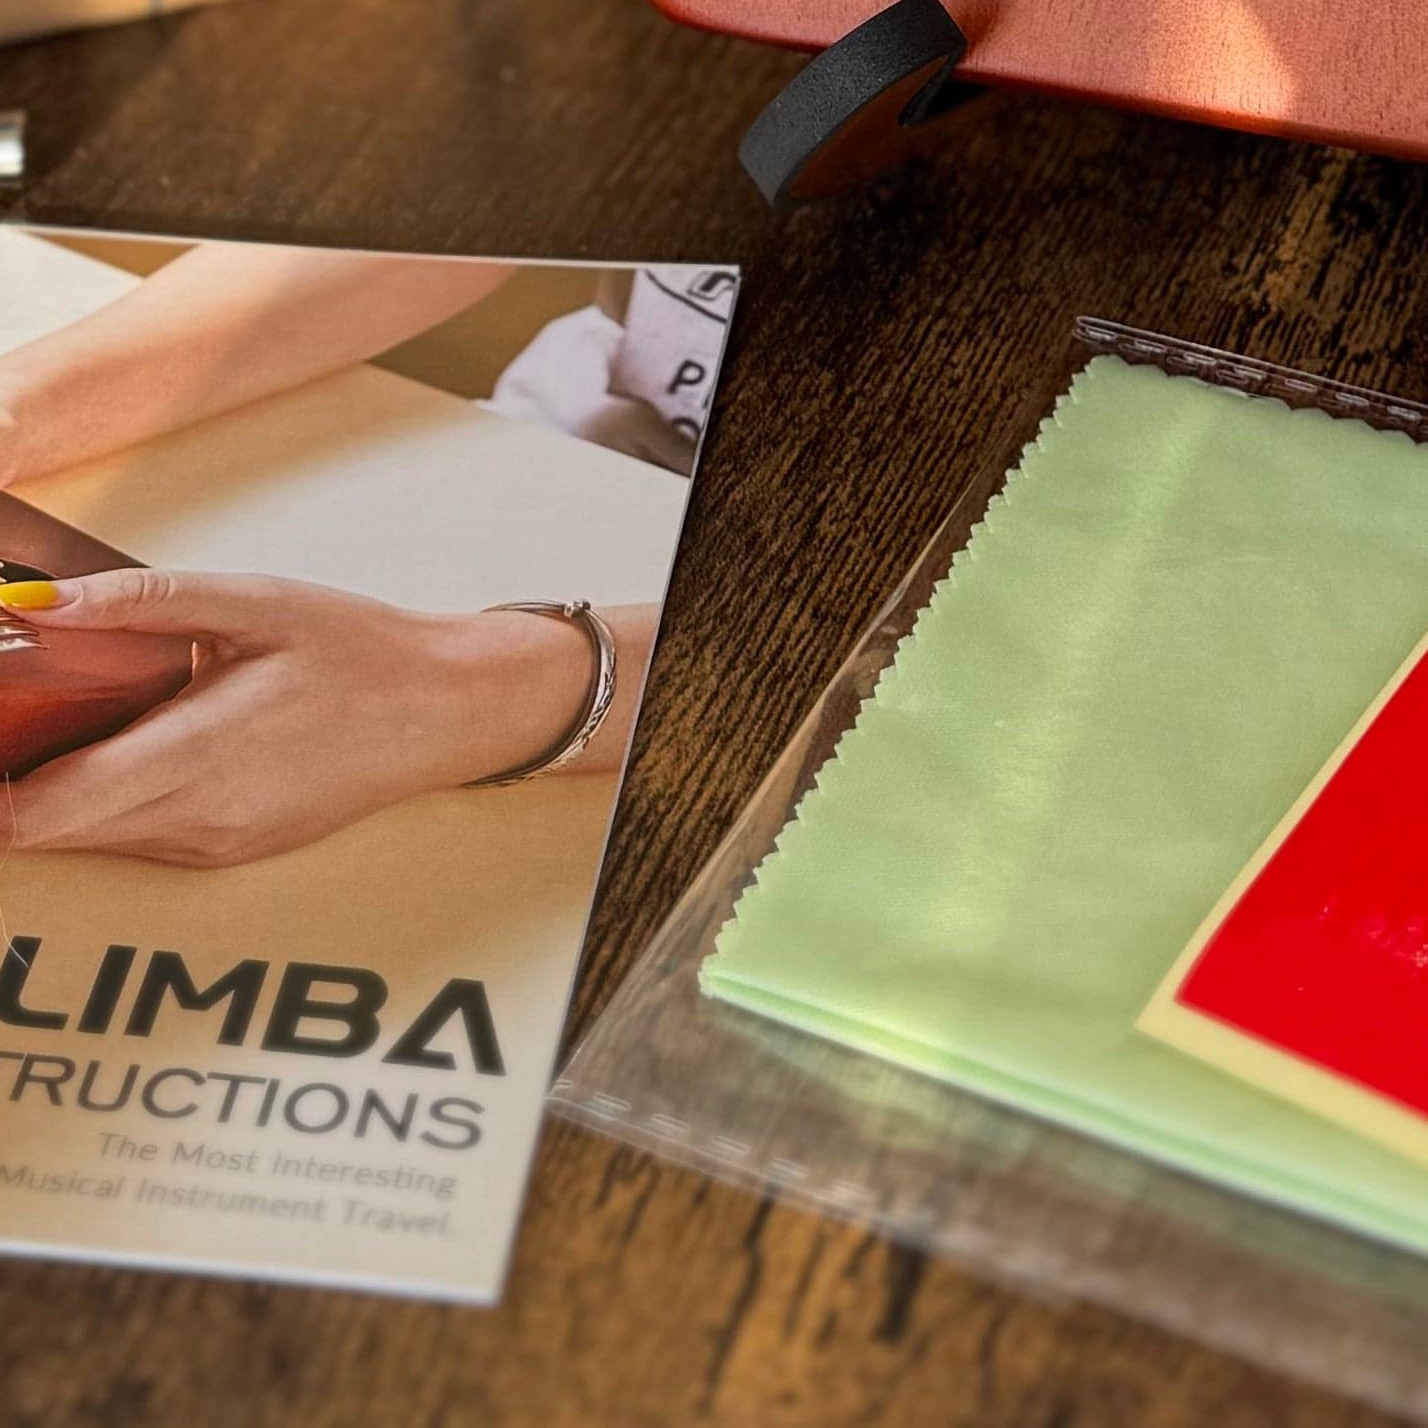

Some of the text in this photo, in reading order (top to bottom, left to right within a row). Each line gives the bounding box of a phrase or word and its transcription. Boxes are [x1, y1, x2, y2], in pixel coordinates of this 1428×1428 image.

[98, 1131, 459, 1202] The Most Interesting
[134, 1177, 325, 1223] Instrument
